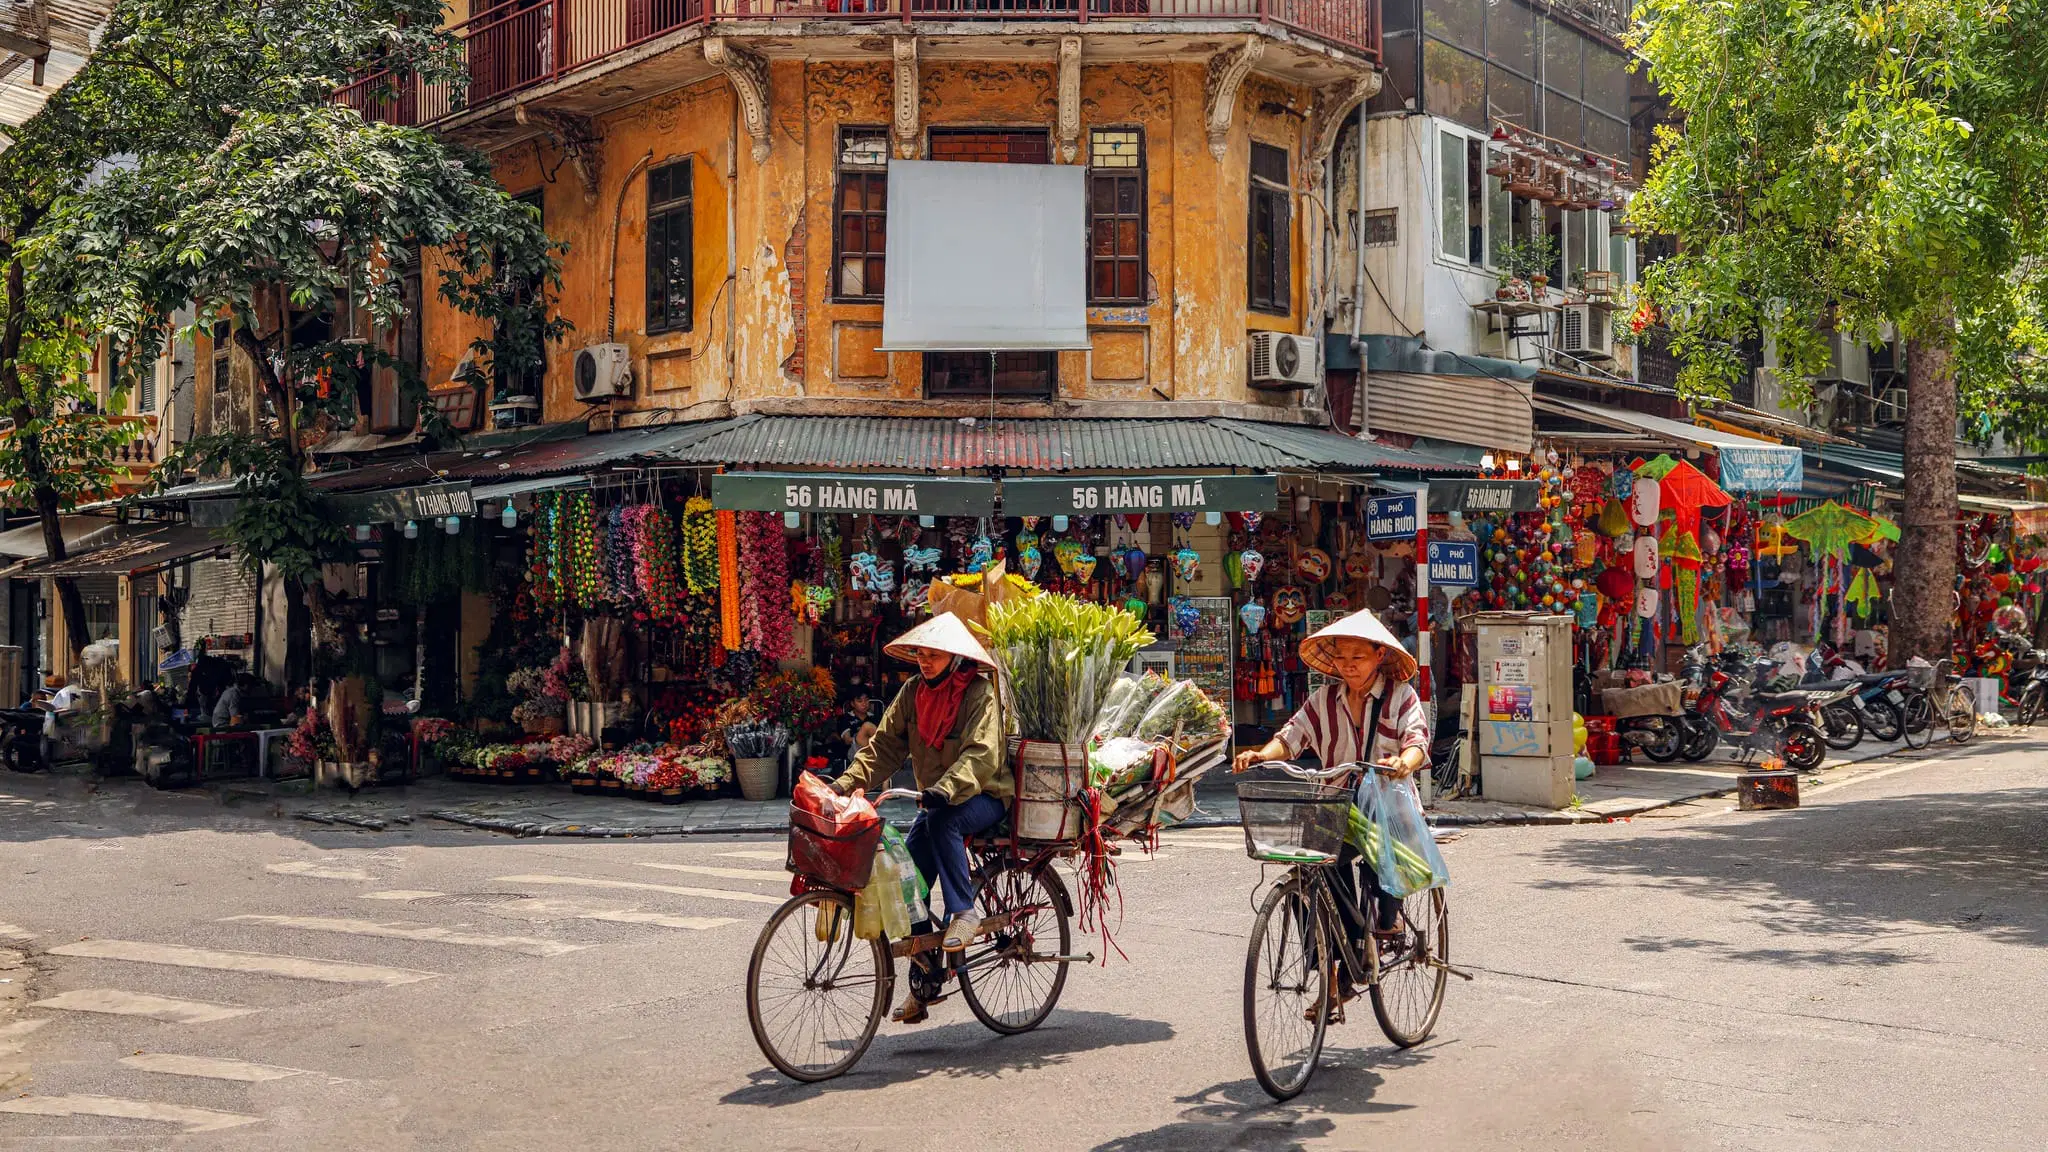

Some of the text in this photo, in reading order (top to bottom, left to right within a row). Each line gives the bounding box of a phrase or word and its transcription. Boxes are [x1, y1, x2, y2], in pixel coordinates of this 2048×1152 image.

[416, 495, 427, 515] 17
[425, 490, 450, 515] HÀNG
[785, 481, 918, 511] 56 HÀNG MÃ
[1072, 479, 1206, 509] 56 HÀNG MÃ
[1466, 487, 1478, 508] 56
[1476, 484, 1500, 508] HÀNG
[1387, 501, 1404, 513] PHỐ
[1370, 515, 1415, 535] HÀNG RƯƠI
[1449, 548, 1465, 559] PHỐ
[1431, 560, 1473, 580] HÀNG MÃ
